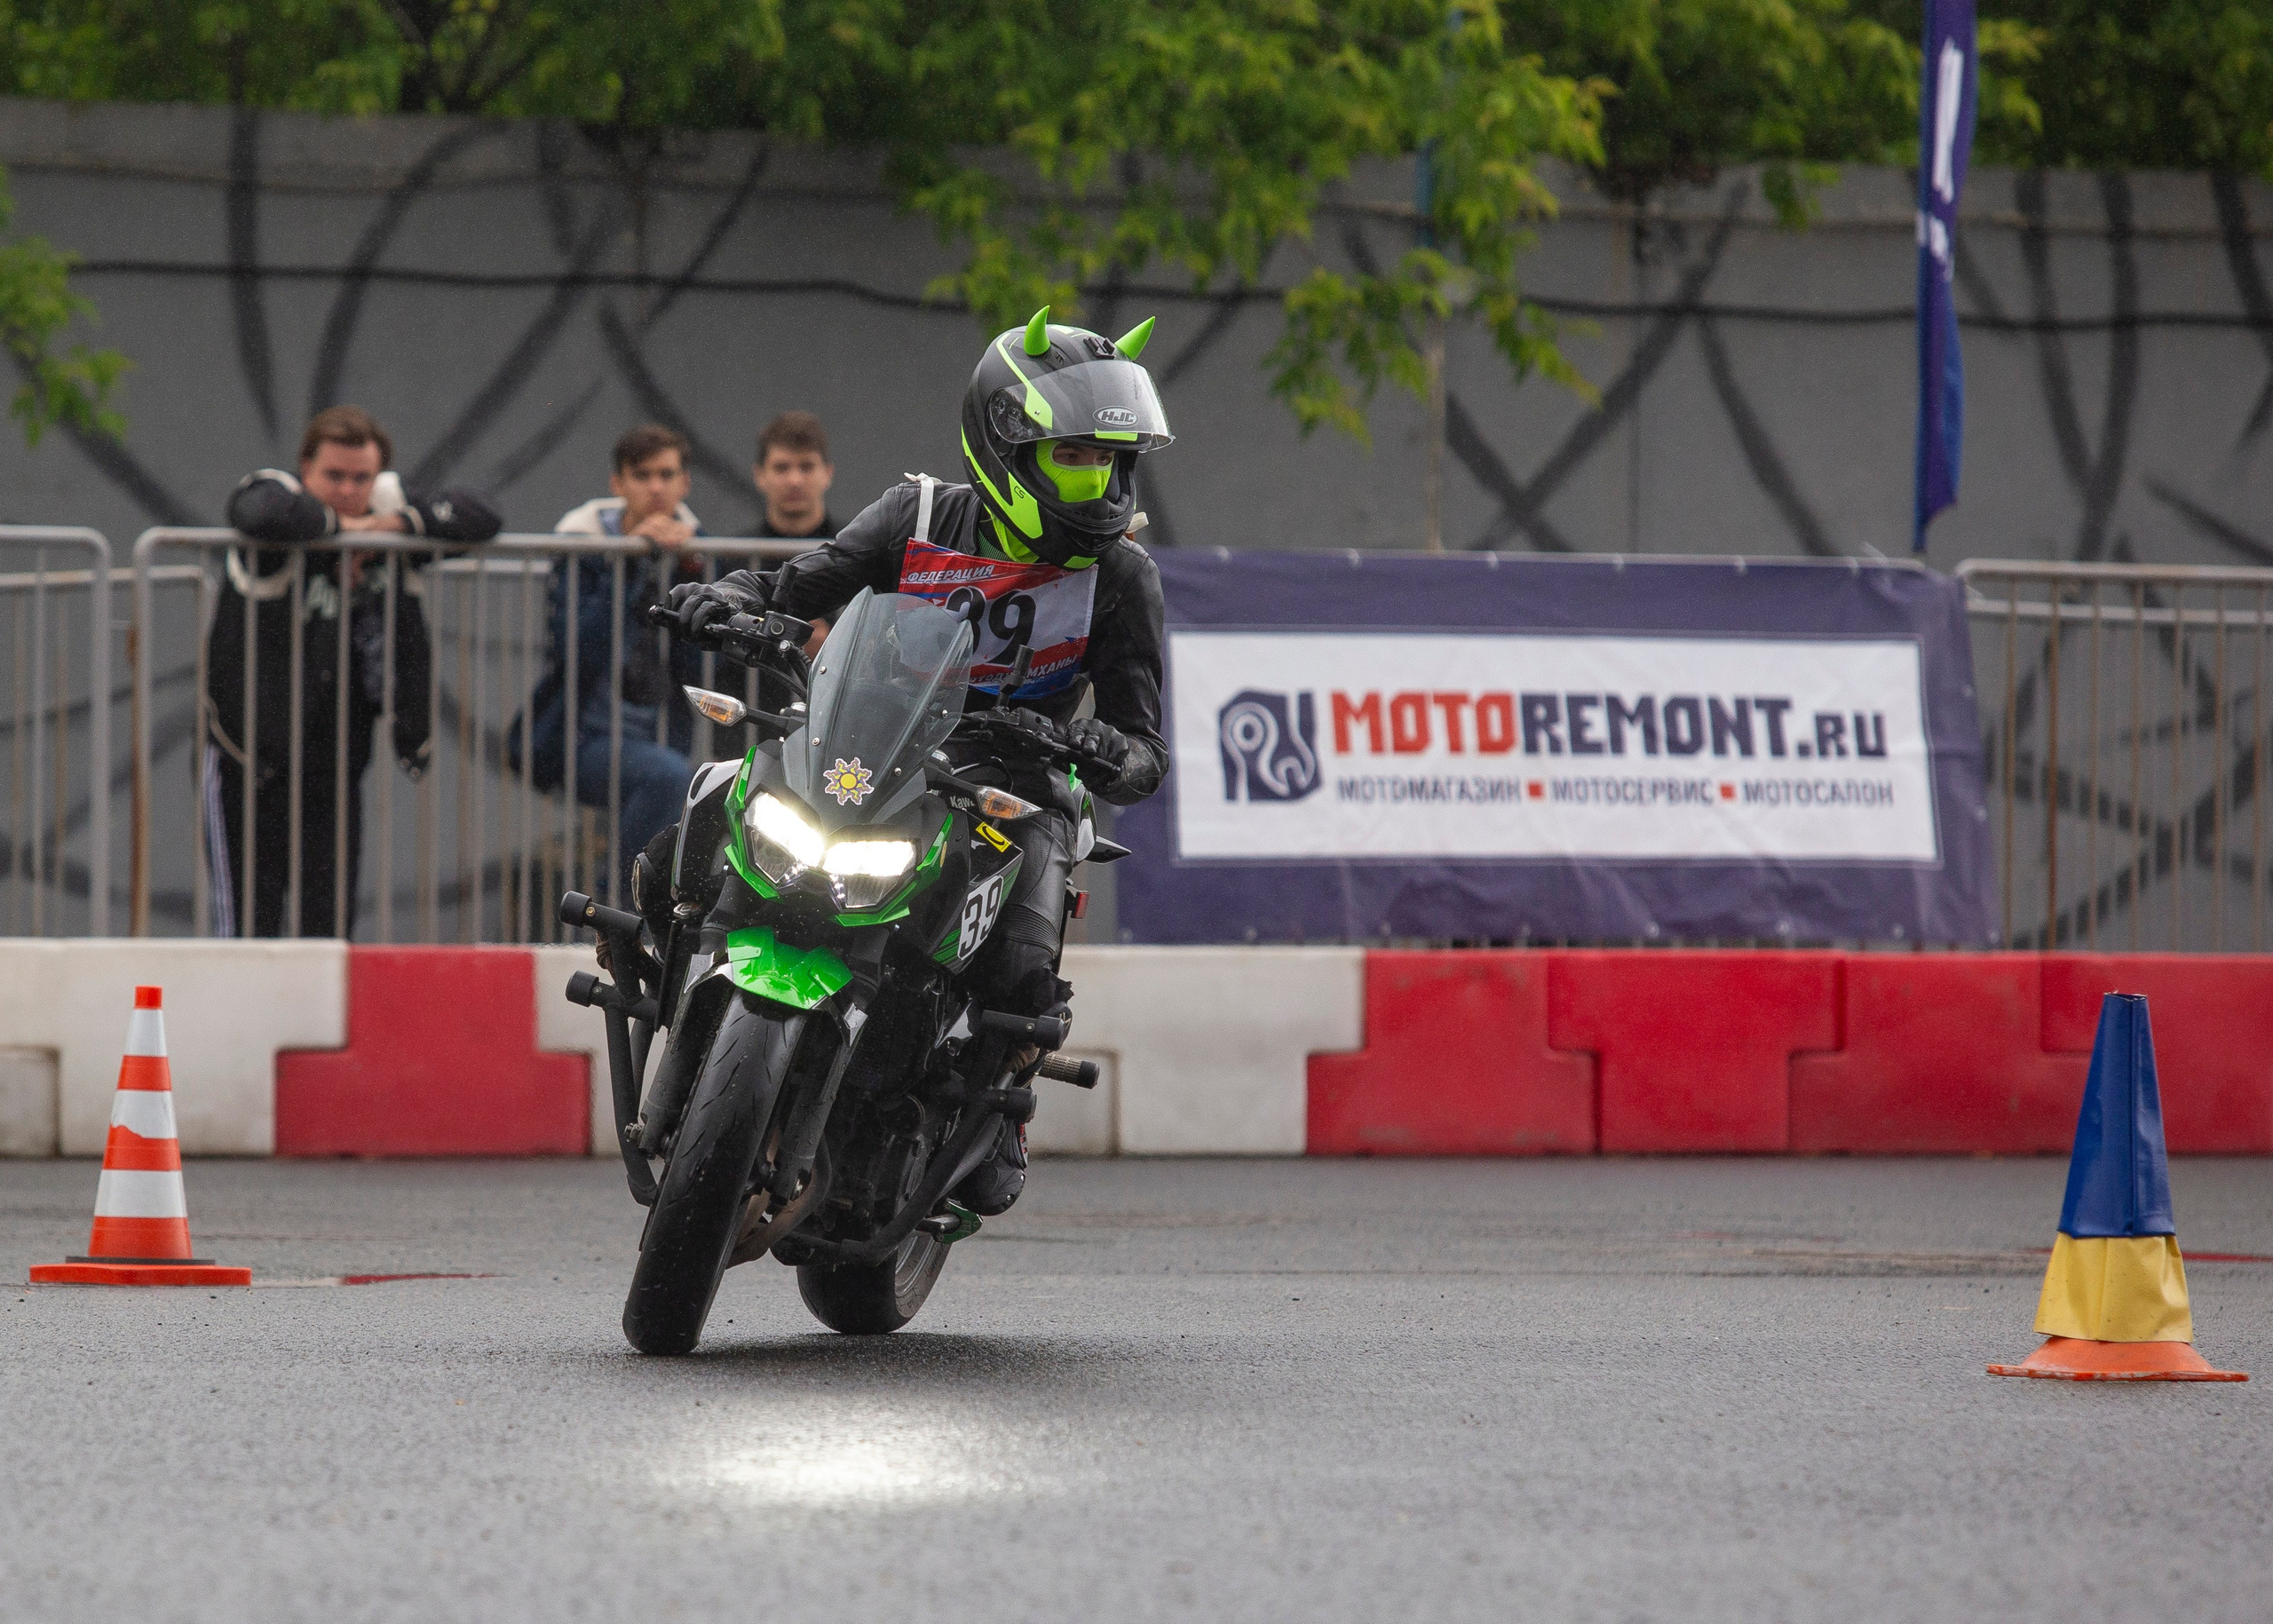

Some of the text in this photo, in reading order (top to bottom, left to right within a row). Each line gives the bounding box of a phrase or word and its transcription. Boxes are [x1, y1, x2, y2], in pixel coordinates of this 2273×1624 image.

[1101, 411, 1134, 423] HJC
[907, 564, 995, 584] ФЕДЕРАЦИЯ
[1331, 690, 1889, 759] MOTOREMONT.RU
[1337, 775, 1894, 807] МОТОМАГАЗИН МОТОСЕРВИС МОТОСАЛОН
[961, 877, 1002, 955] 39
